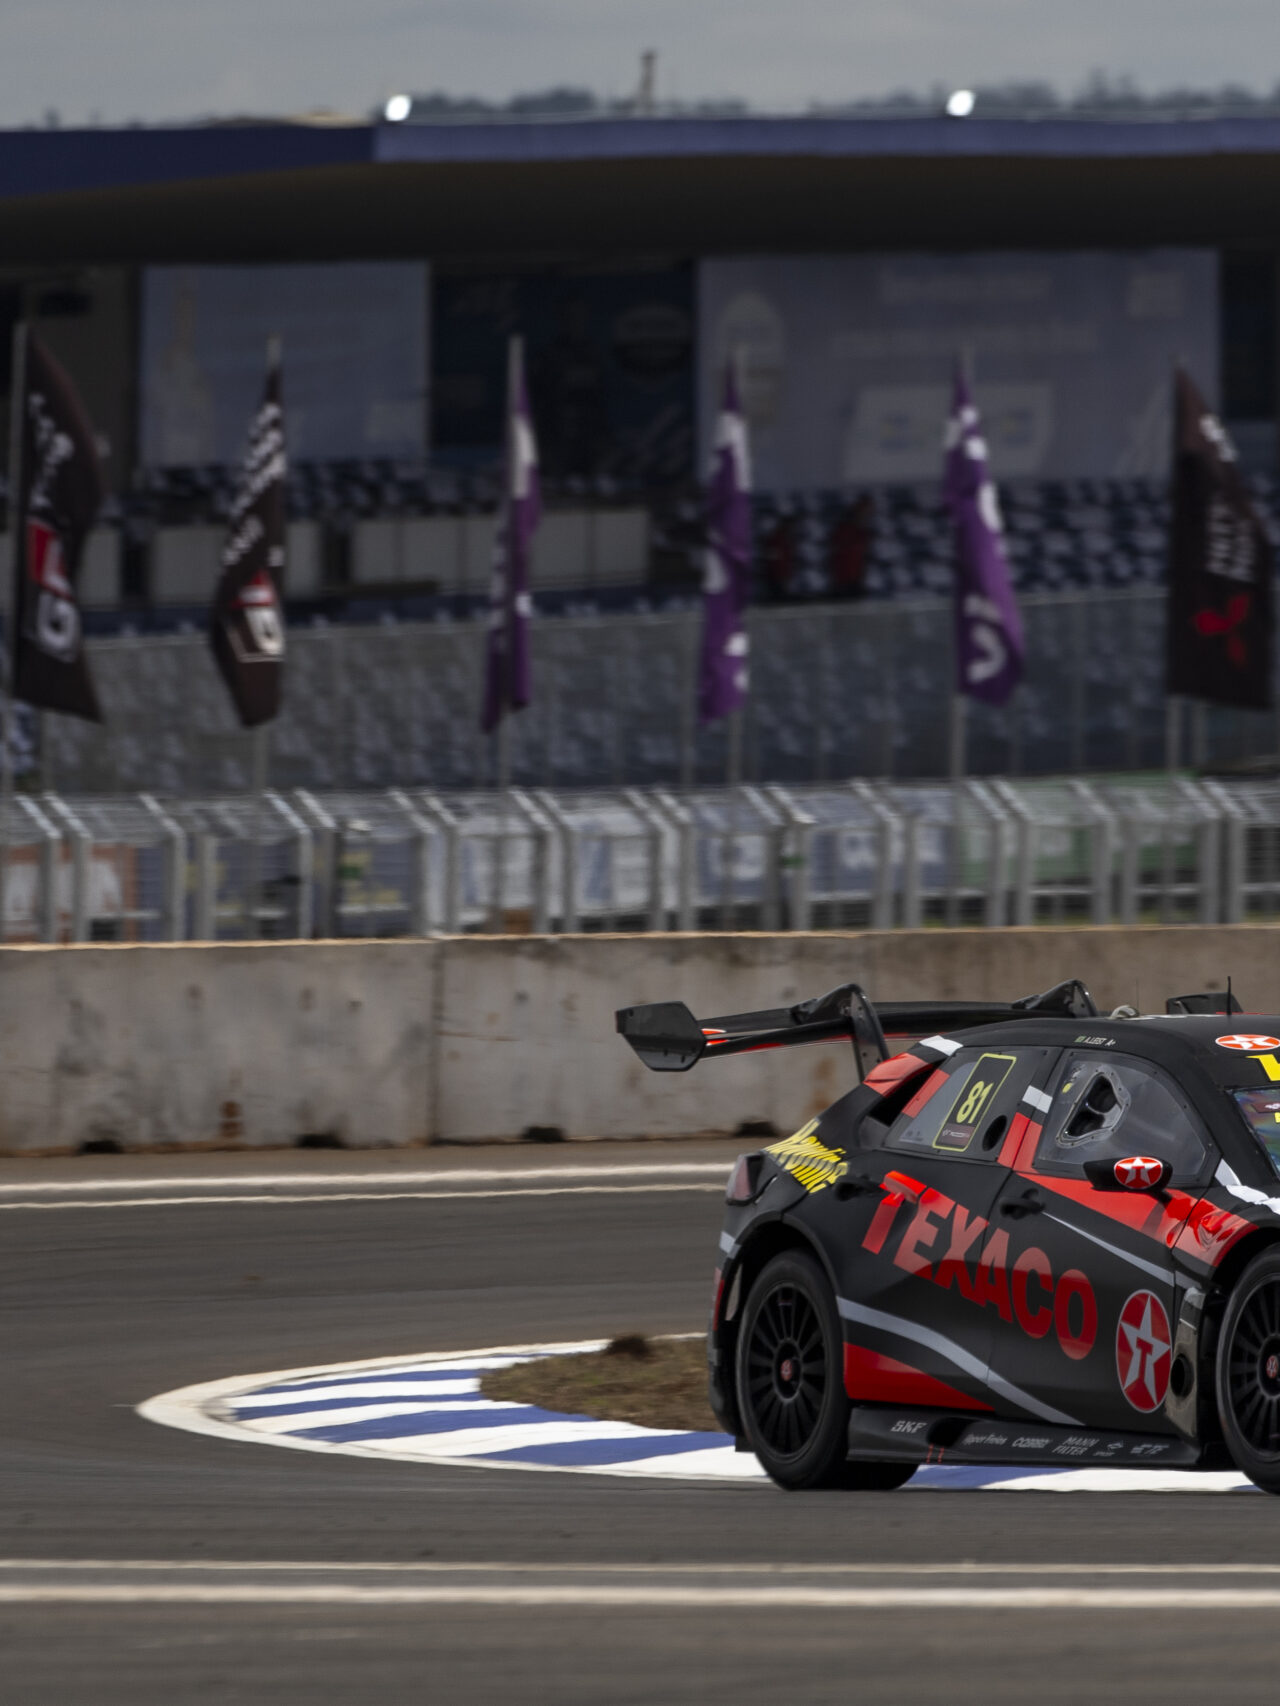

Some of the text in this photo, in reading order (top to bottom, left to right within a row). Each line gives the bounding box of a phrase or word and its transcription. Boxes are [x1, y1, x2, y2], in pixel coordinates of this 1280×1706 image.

[956, 1080, 994, 1124] 81
[861, 1170, 1098, 1360] TEXACO
[890, 1419, 928, 1434] SKF
